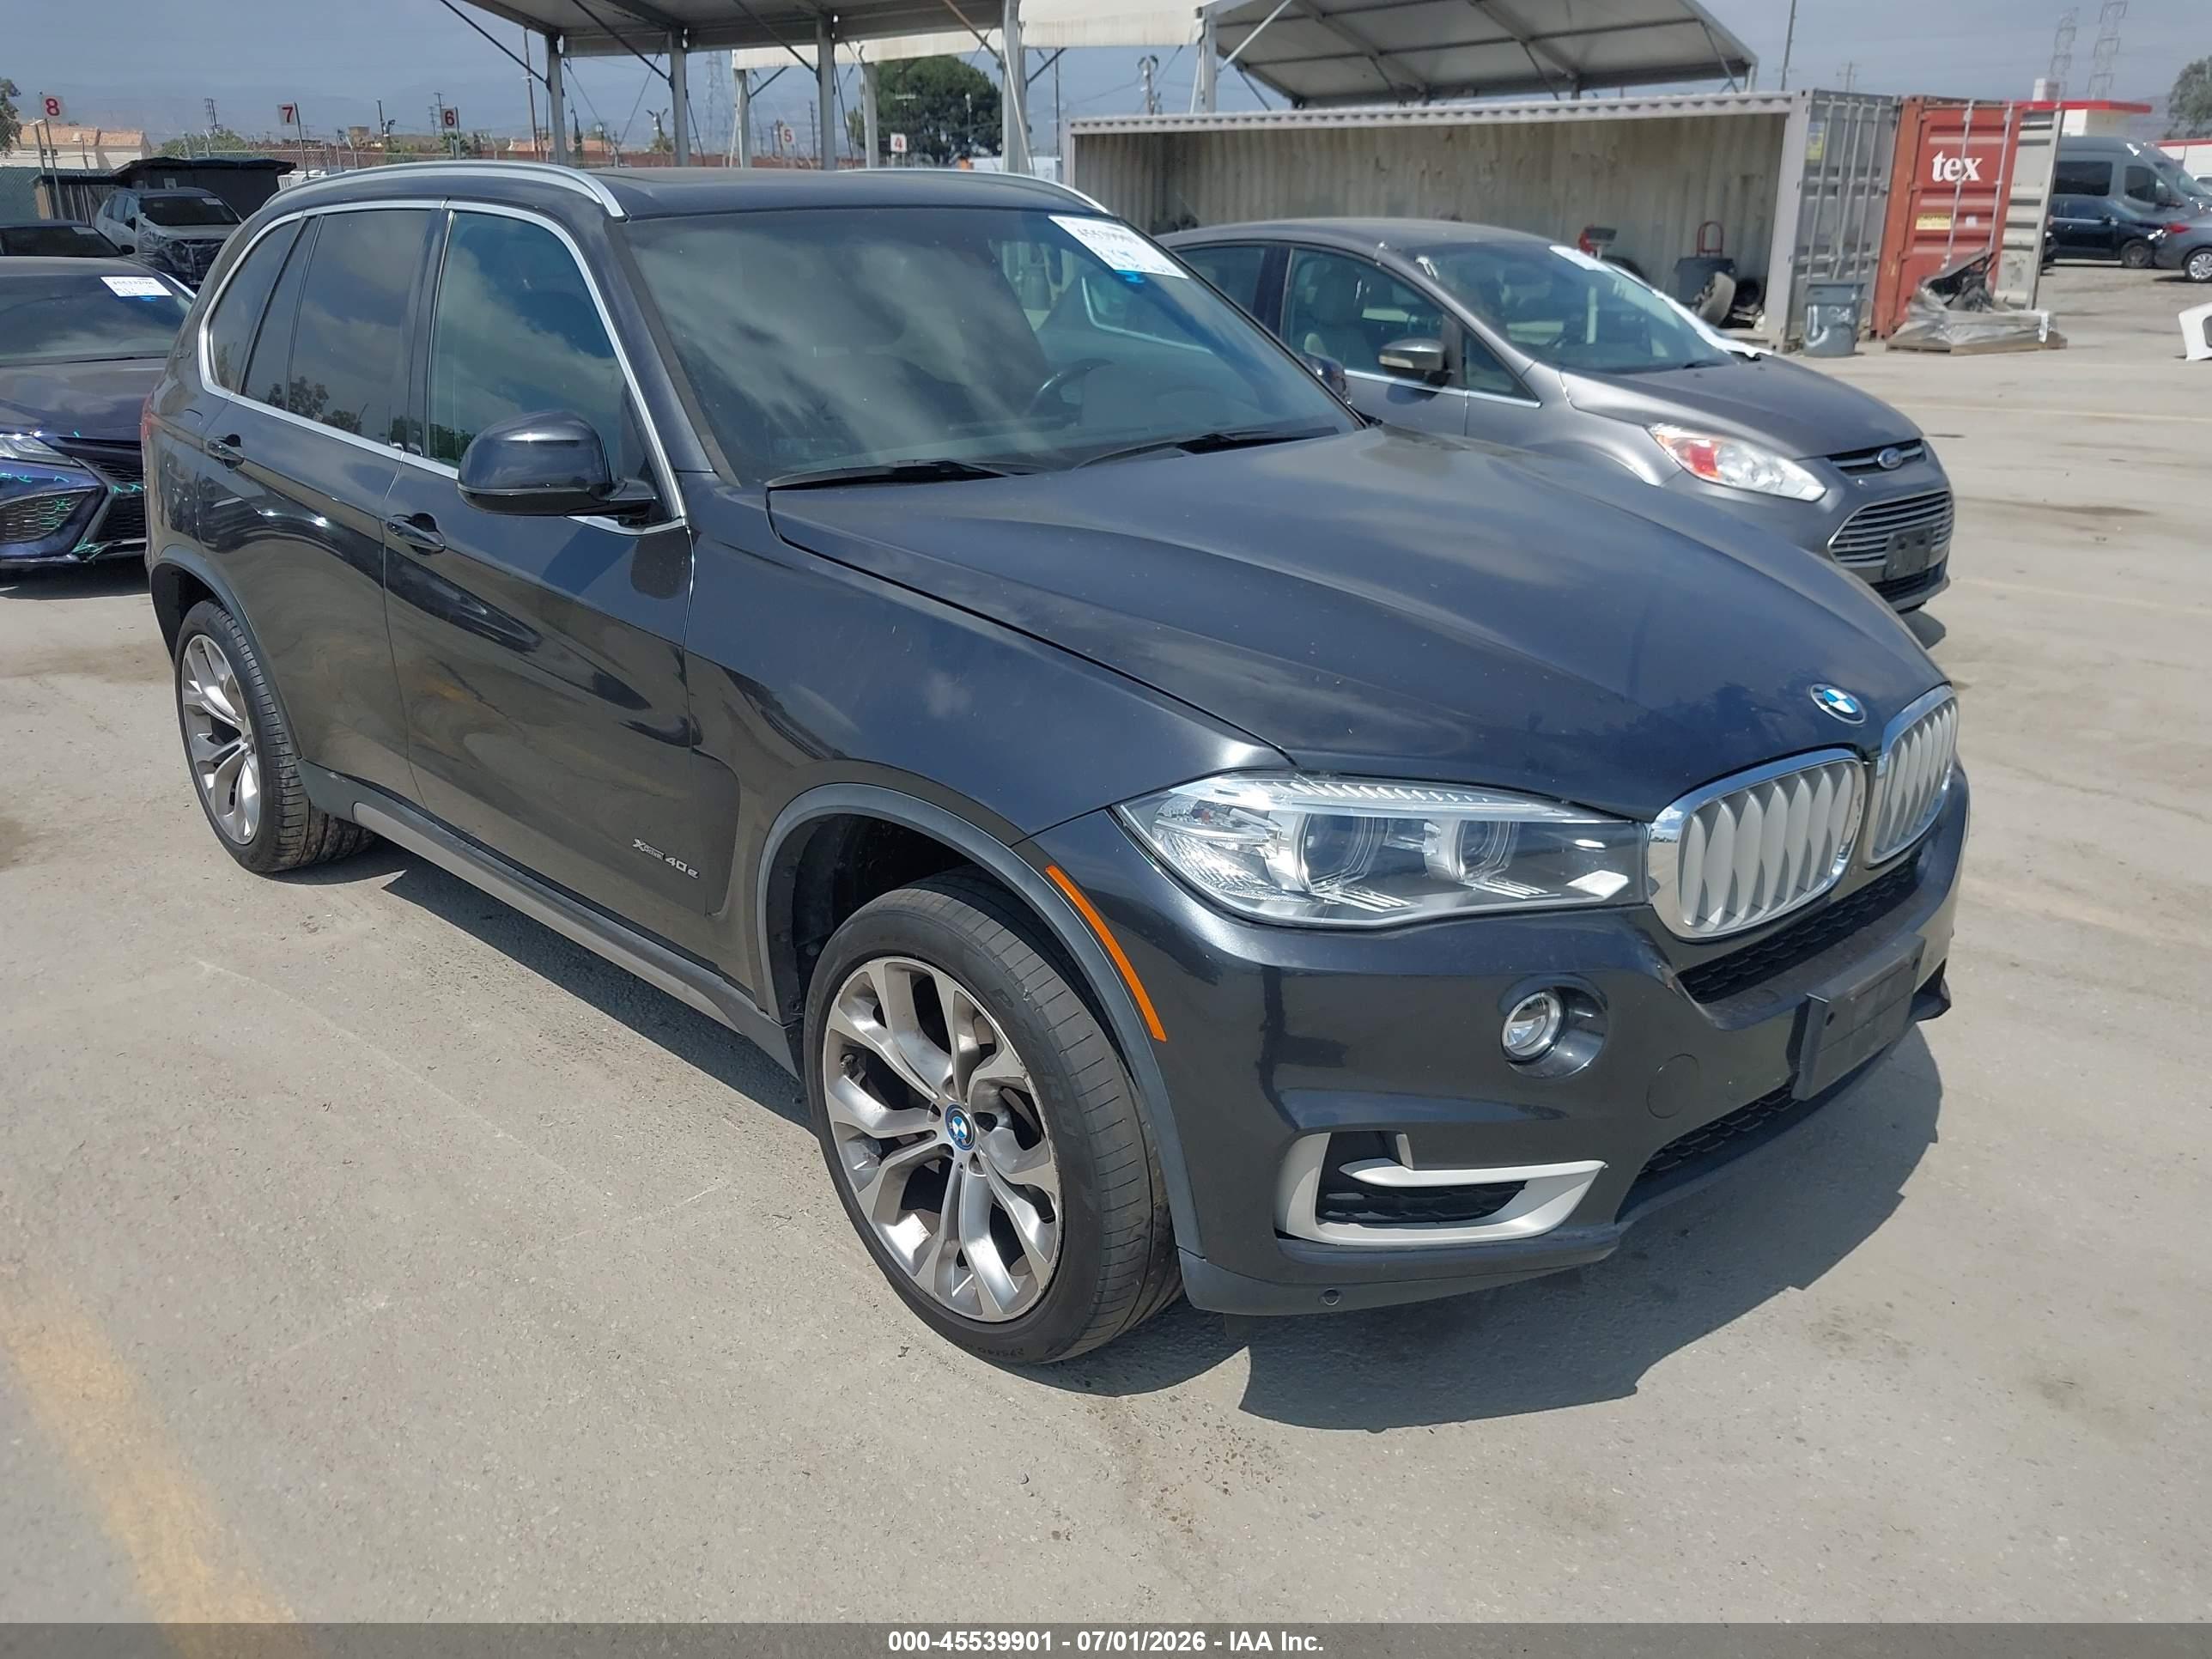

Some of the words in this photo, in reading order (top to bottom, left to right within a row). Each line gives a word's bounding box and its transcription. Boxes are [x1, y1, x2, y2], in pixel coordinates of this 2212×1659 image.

[46, 98, 60, 117] 8
[282, 106, 294, 124] 7
[445, 111, 455, 126] 6
[783, 129, 793, 143] 5
[894, 137, 903, 151] 4
[1932, 149, 1984, 183] tex
